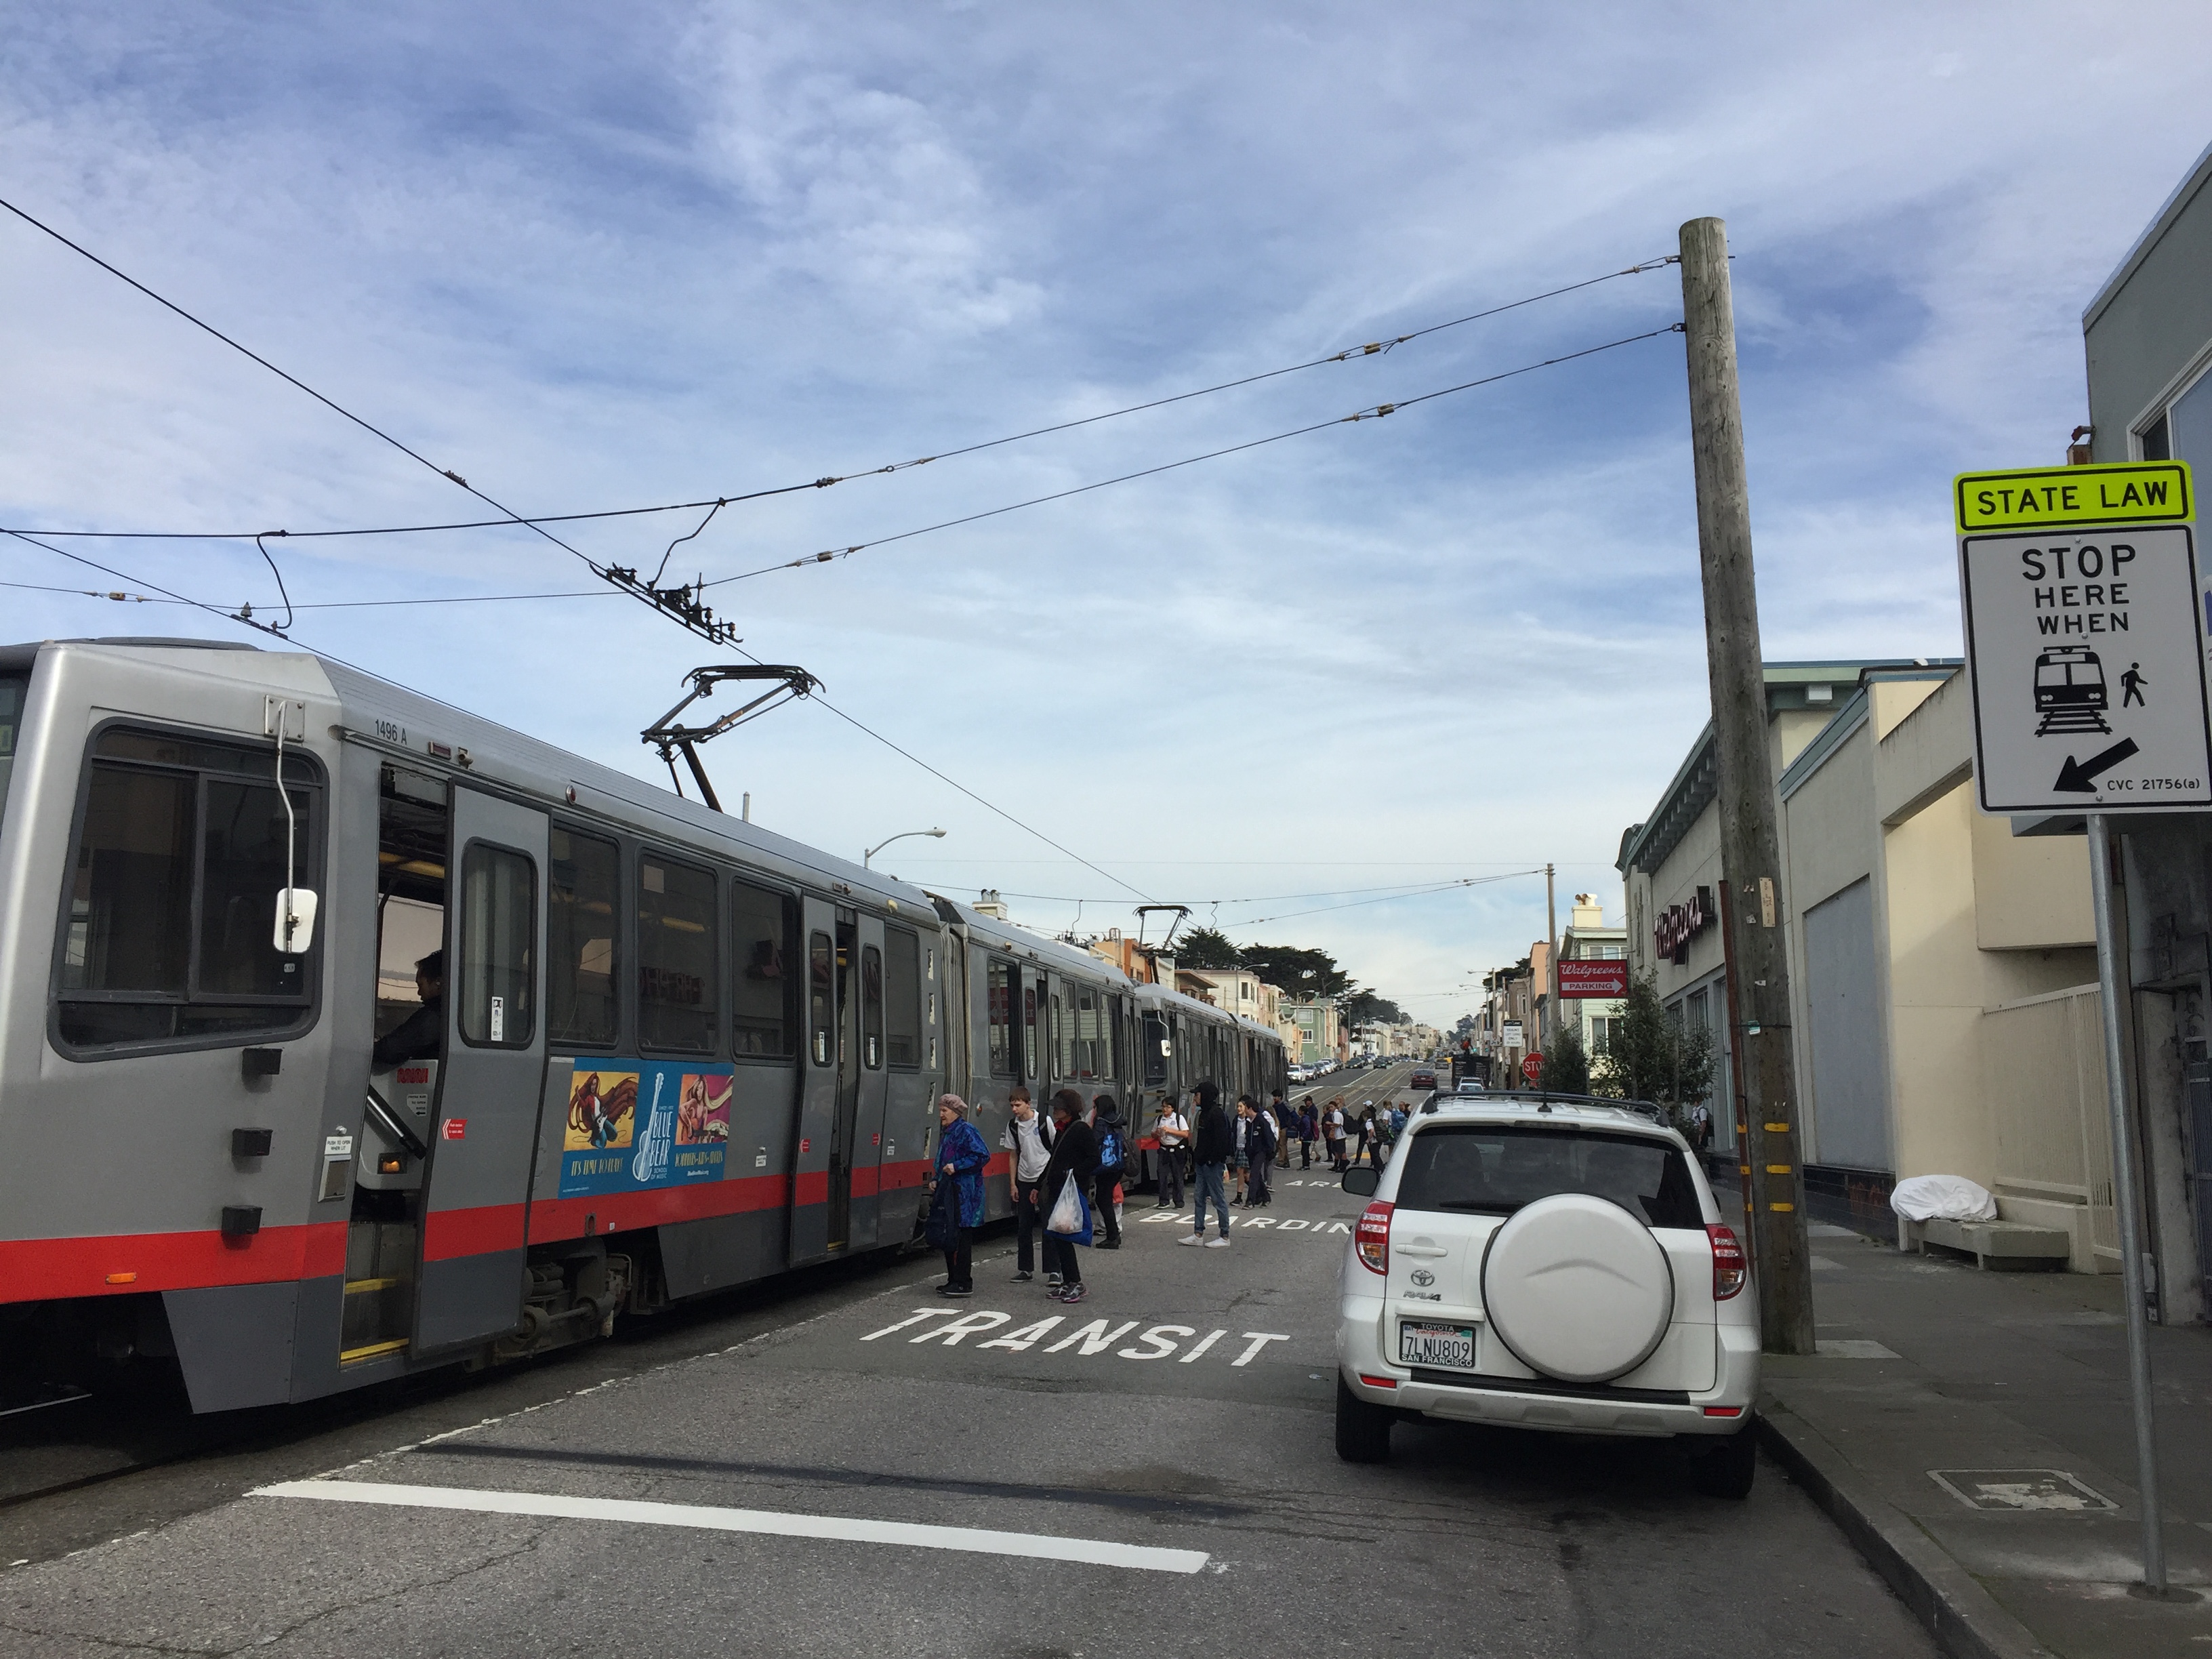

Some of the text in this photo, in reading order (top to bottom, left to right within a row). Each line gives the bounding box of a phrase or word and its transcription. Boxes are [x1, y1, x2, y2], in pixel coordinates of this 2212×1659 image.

[1978, 480, 2168, 516] STATE LAW
[2022, 544, 2136, 581] STOP
[2034, 583, 2129, 609] HERE
[2036, 612, 2129, 635] WHEN
[375, 718, 407, 745] 1496 A
[2107, 778, 2200, 792] CVC 21756(a)
[1561, 964, 1624, 978] Walgreens
[1525, 1061, 1544, 1072] STO
[653, 1111, 673, 1139] BLUE
[649, 1139, 671, 1167] BEAR
[1139, 1212, 1351, 1234] BOARDIN
[1403, 1290, 1442, 1301] RAV4
[859, 1307, 1290, 1366] TRANSIT
[1420, 1323, 1454, 1332] TOYOTA
[1406, 1336, 1470, 1360] 7LNU809
[1402, 1353, 1473, 1367] SAN FRANCISCO
